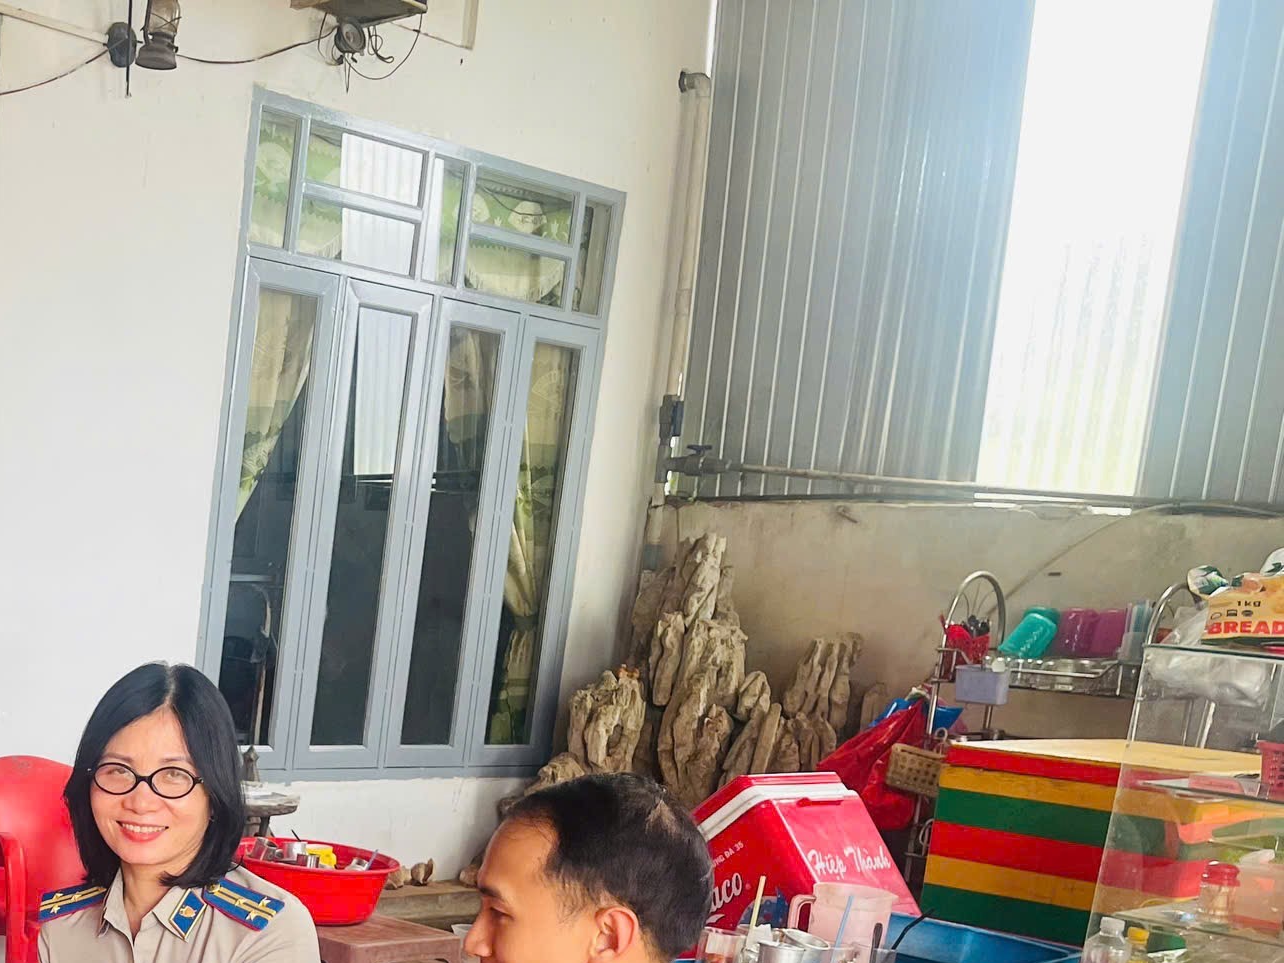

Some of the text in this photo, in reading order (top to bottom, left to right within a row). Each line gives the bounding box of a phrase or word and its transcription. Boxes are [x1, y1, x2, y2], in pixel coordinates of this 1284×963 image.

[1207, 620, 1284, 635] BREAD
[807, 845, 891, 880] Hiệp Thành
